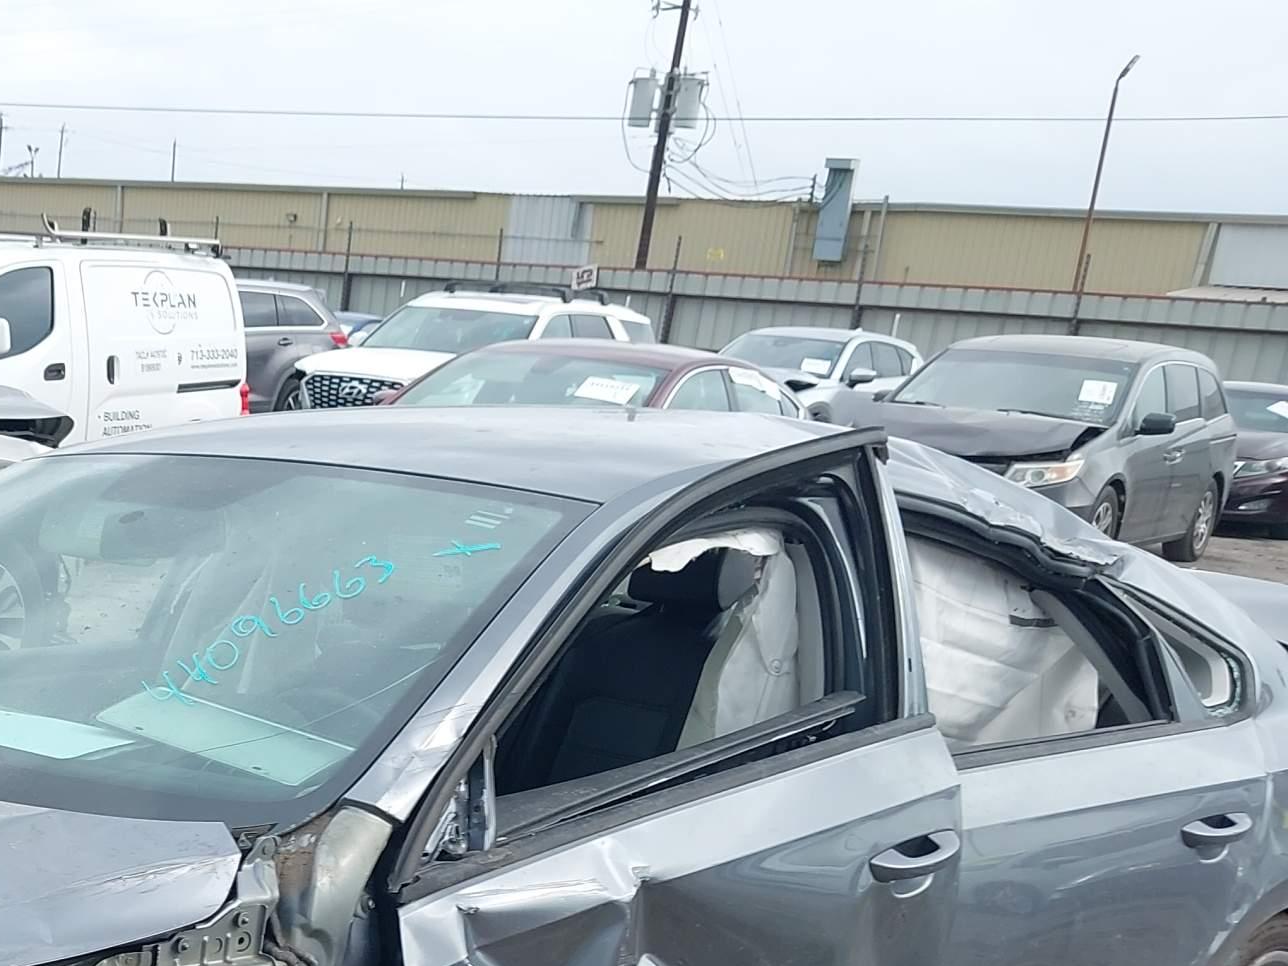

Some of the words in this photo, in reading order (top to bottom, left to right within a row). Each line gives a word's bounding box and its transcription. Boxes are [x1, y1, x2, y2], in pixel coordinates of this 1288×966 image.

[131, 291, 197, 308] TEKPLAN
[104, 409, 140, 422] BUILDING
[142, 554, 396, 706] 44096663
